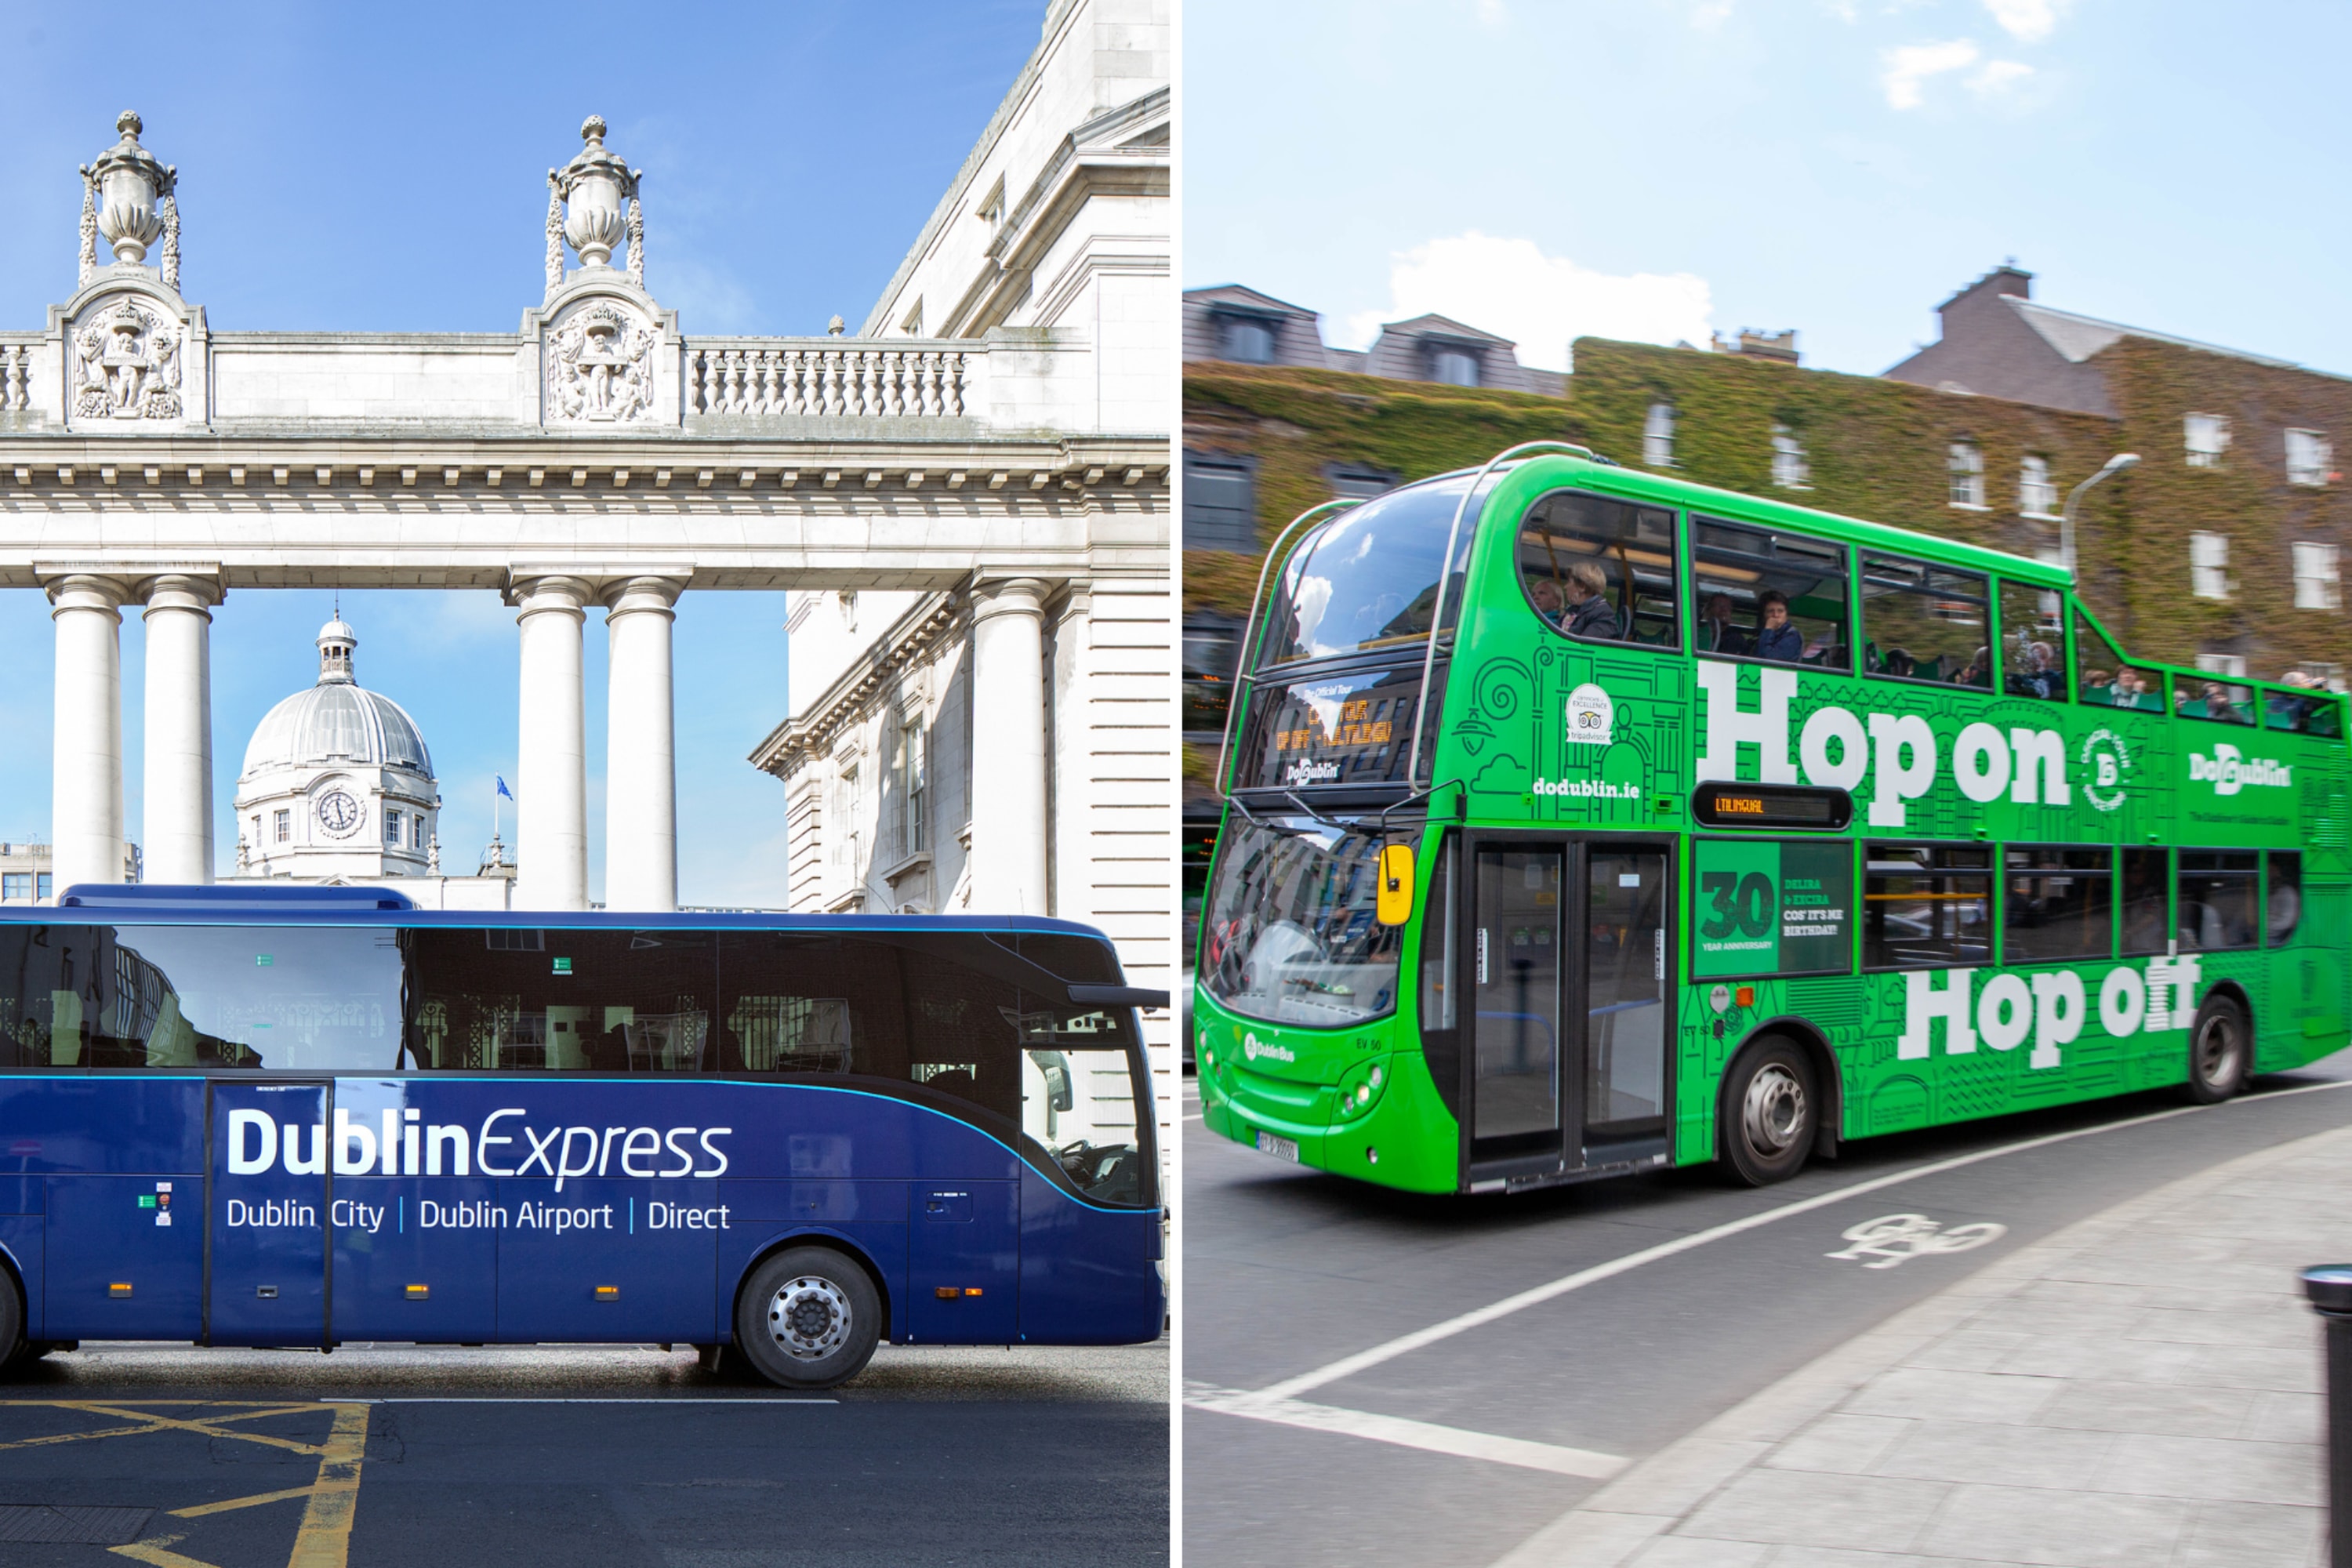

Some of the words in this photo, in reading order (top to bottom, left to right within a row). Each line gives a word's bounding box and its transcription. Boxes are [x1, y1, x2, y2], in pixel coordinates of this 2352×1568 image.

[1315, 685, 1338, 696] Official
[1338, 684, 1353, 695] Tour
[1572, 700, 1608, 710] EXCELLENCE
[1570, 731, 1606, 742] tripadvisor
[1696, 661, 1937, 828] Hop
[1953, 721, 2071, 808] on
[1287, 758, 1339, 786] DoDublin
[2189, 742, 2293, 796] DoDublin
[1533, 777, 1641, 800] dodublin.ie
[1784, 879, 1822, 890] DELIRA
[1700, 871, 1775, 940] 30
[1828, 909, 1844, 920] ME
[1784, 924, 1838, 937] BIRTHDAY!
[1702, 942, 1722, 952] YEAR
[1723, 941, 1773, 951] ANNIVERSARY
[1897, 967, 2086, 1069] Hop
[2100, 940, 2203, 1037] off
[1257, 1041, 1279, 1059] Dublin
[1279, 1046, 1295, 1063] Bus
[1356, 1038, 1368, 1050] EV
[1370, 1040, 1382, 1051] 50
[228, 1200, 316, 1229] Dublin
[332, 1200, 385, 1235] City
[421, 1200, 509, 1229] Dublin
[517, 1201, 615, 1236] Airport
[649, 1202, 731, 1230] Direct
